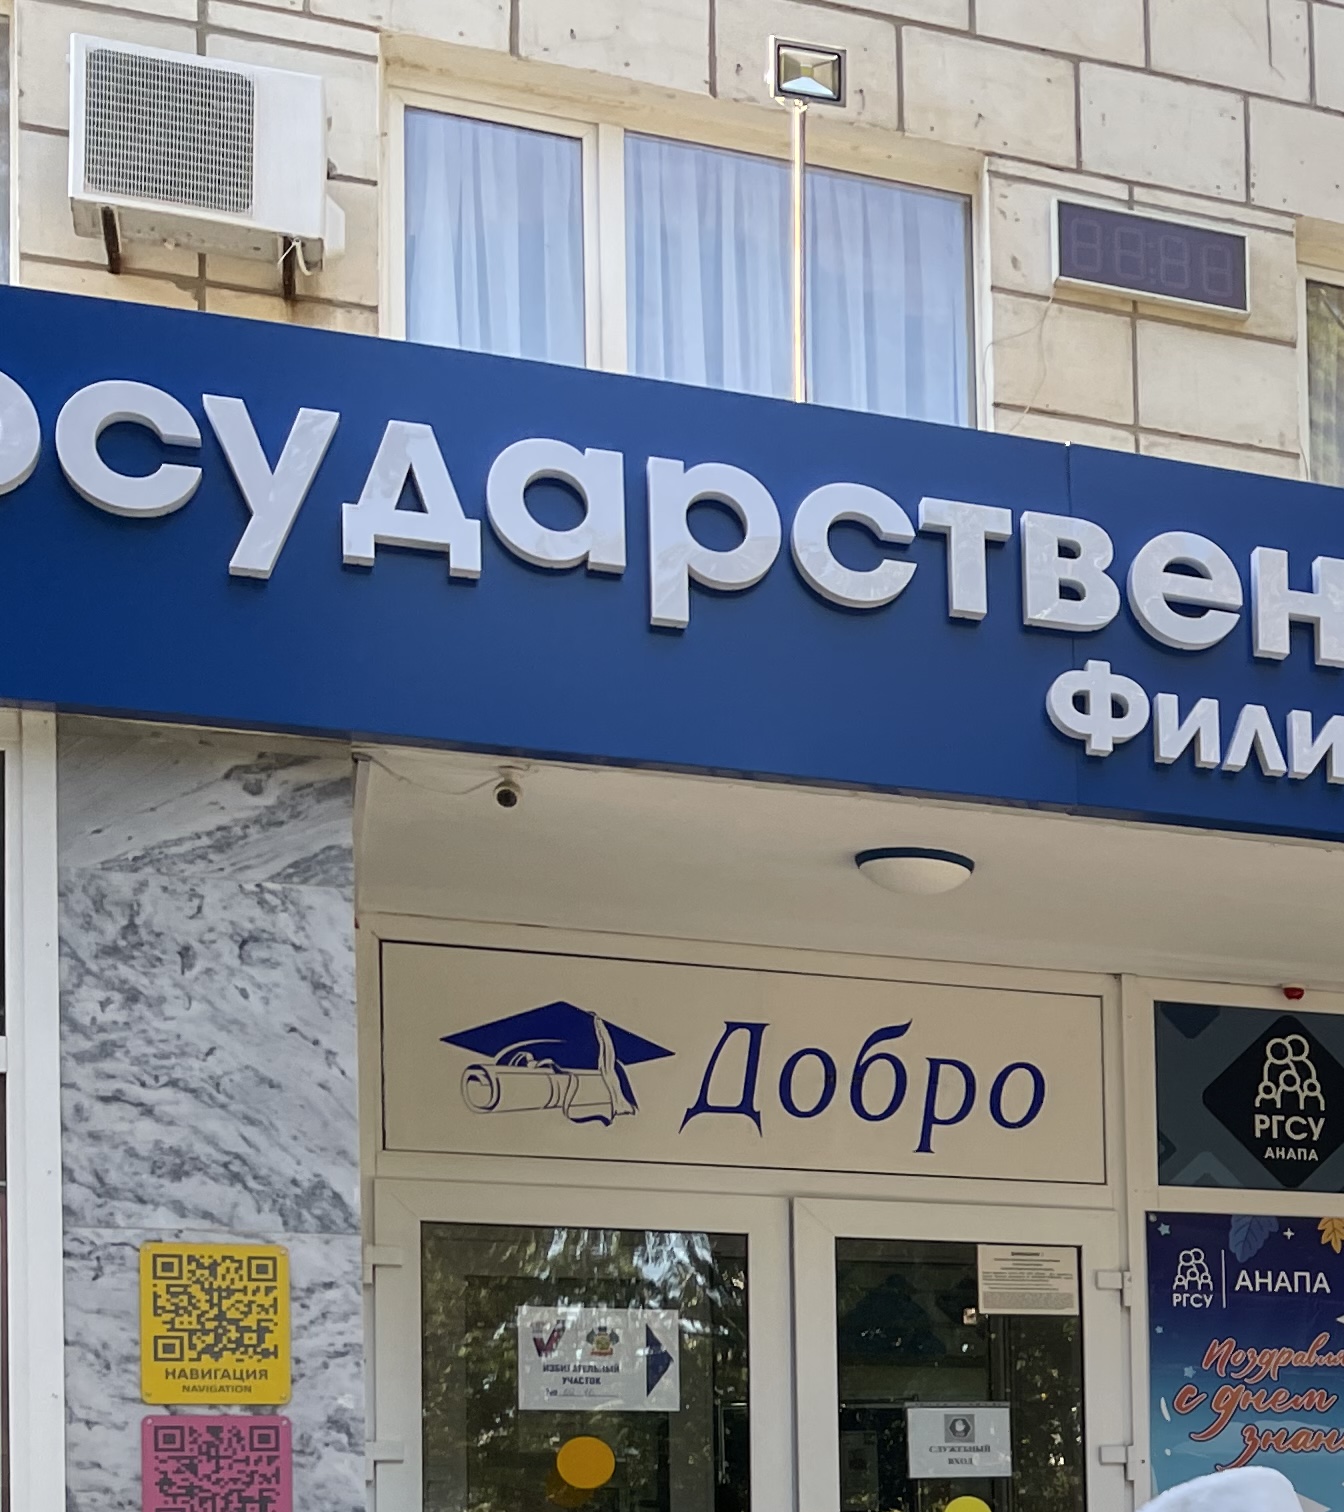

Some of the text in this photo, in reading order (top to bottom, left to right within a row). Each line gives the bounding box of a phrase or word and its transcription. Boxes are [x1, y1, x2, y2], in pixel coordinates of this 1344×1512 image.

[678, 1018, 1046, 1154] Добро
[1254, 1114, 1326, 1142] РГСУ
[1264, 1147, 1319, 1162] АНАПА
[1234, 1269, 1331, 1293] АНАПА
[1172, 1292, 1214, 1309] РГСУ
[165, 1368, 268, 1382] НАВИГАЦИЯ
[562, 1376, 601, 1386] УЧАСТОК
[182, 1385, 252, 1393] NAVIGATION
[1173, 1382, 1338, 1442] с днем
